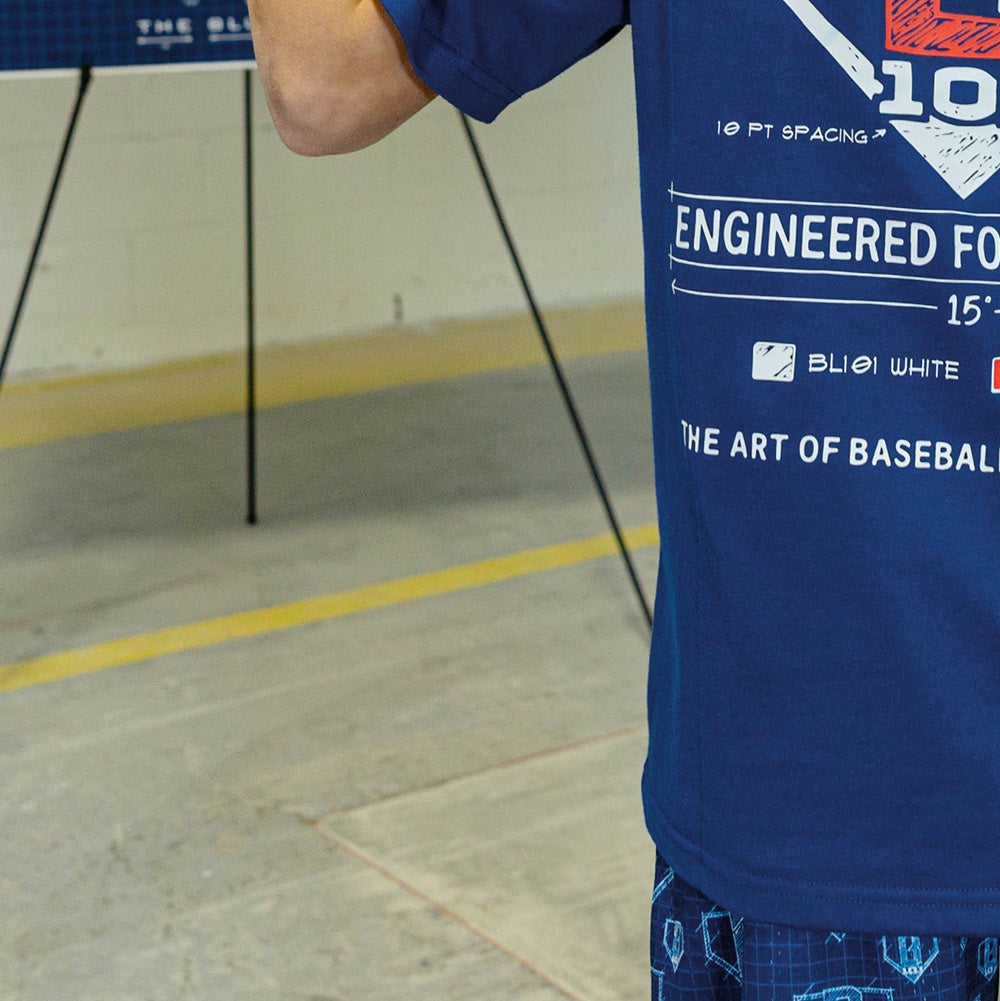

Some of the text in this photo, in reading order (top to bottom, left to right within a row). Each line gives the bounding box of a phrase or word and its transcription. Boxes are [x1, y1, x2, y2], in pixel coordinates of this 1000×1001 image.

[136, 17, 193, 34] THE
[717, 120, 868, 145] 10 PT SPACING
[674, 206, 938, 267] ENGINEERED
[890, 357, 960, 380] WHITE
[681, 419, 720, 456] THE
[729, 431, 789, 461] ART
[799, 434, 841, 464] OF
